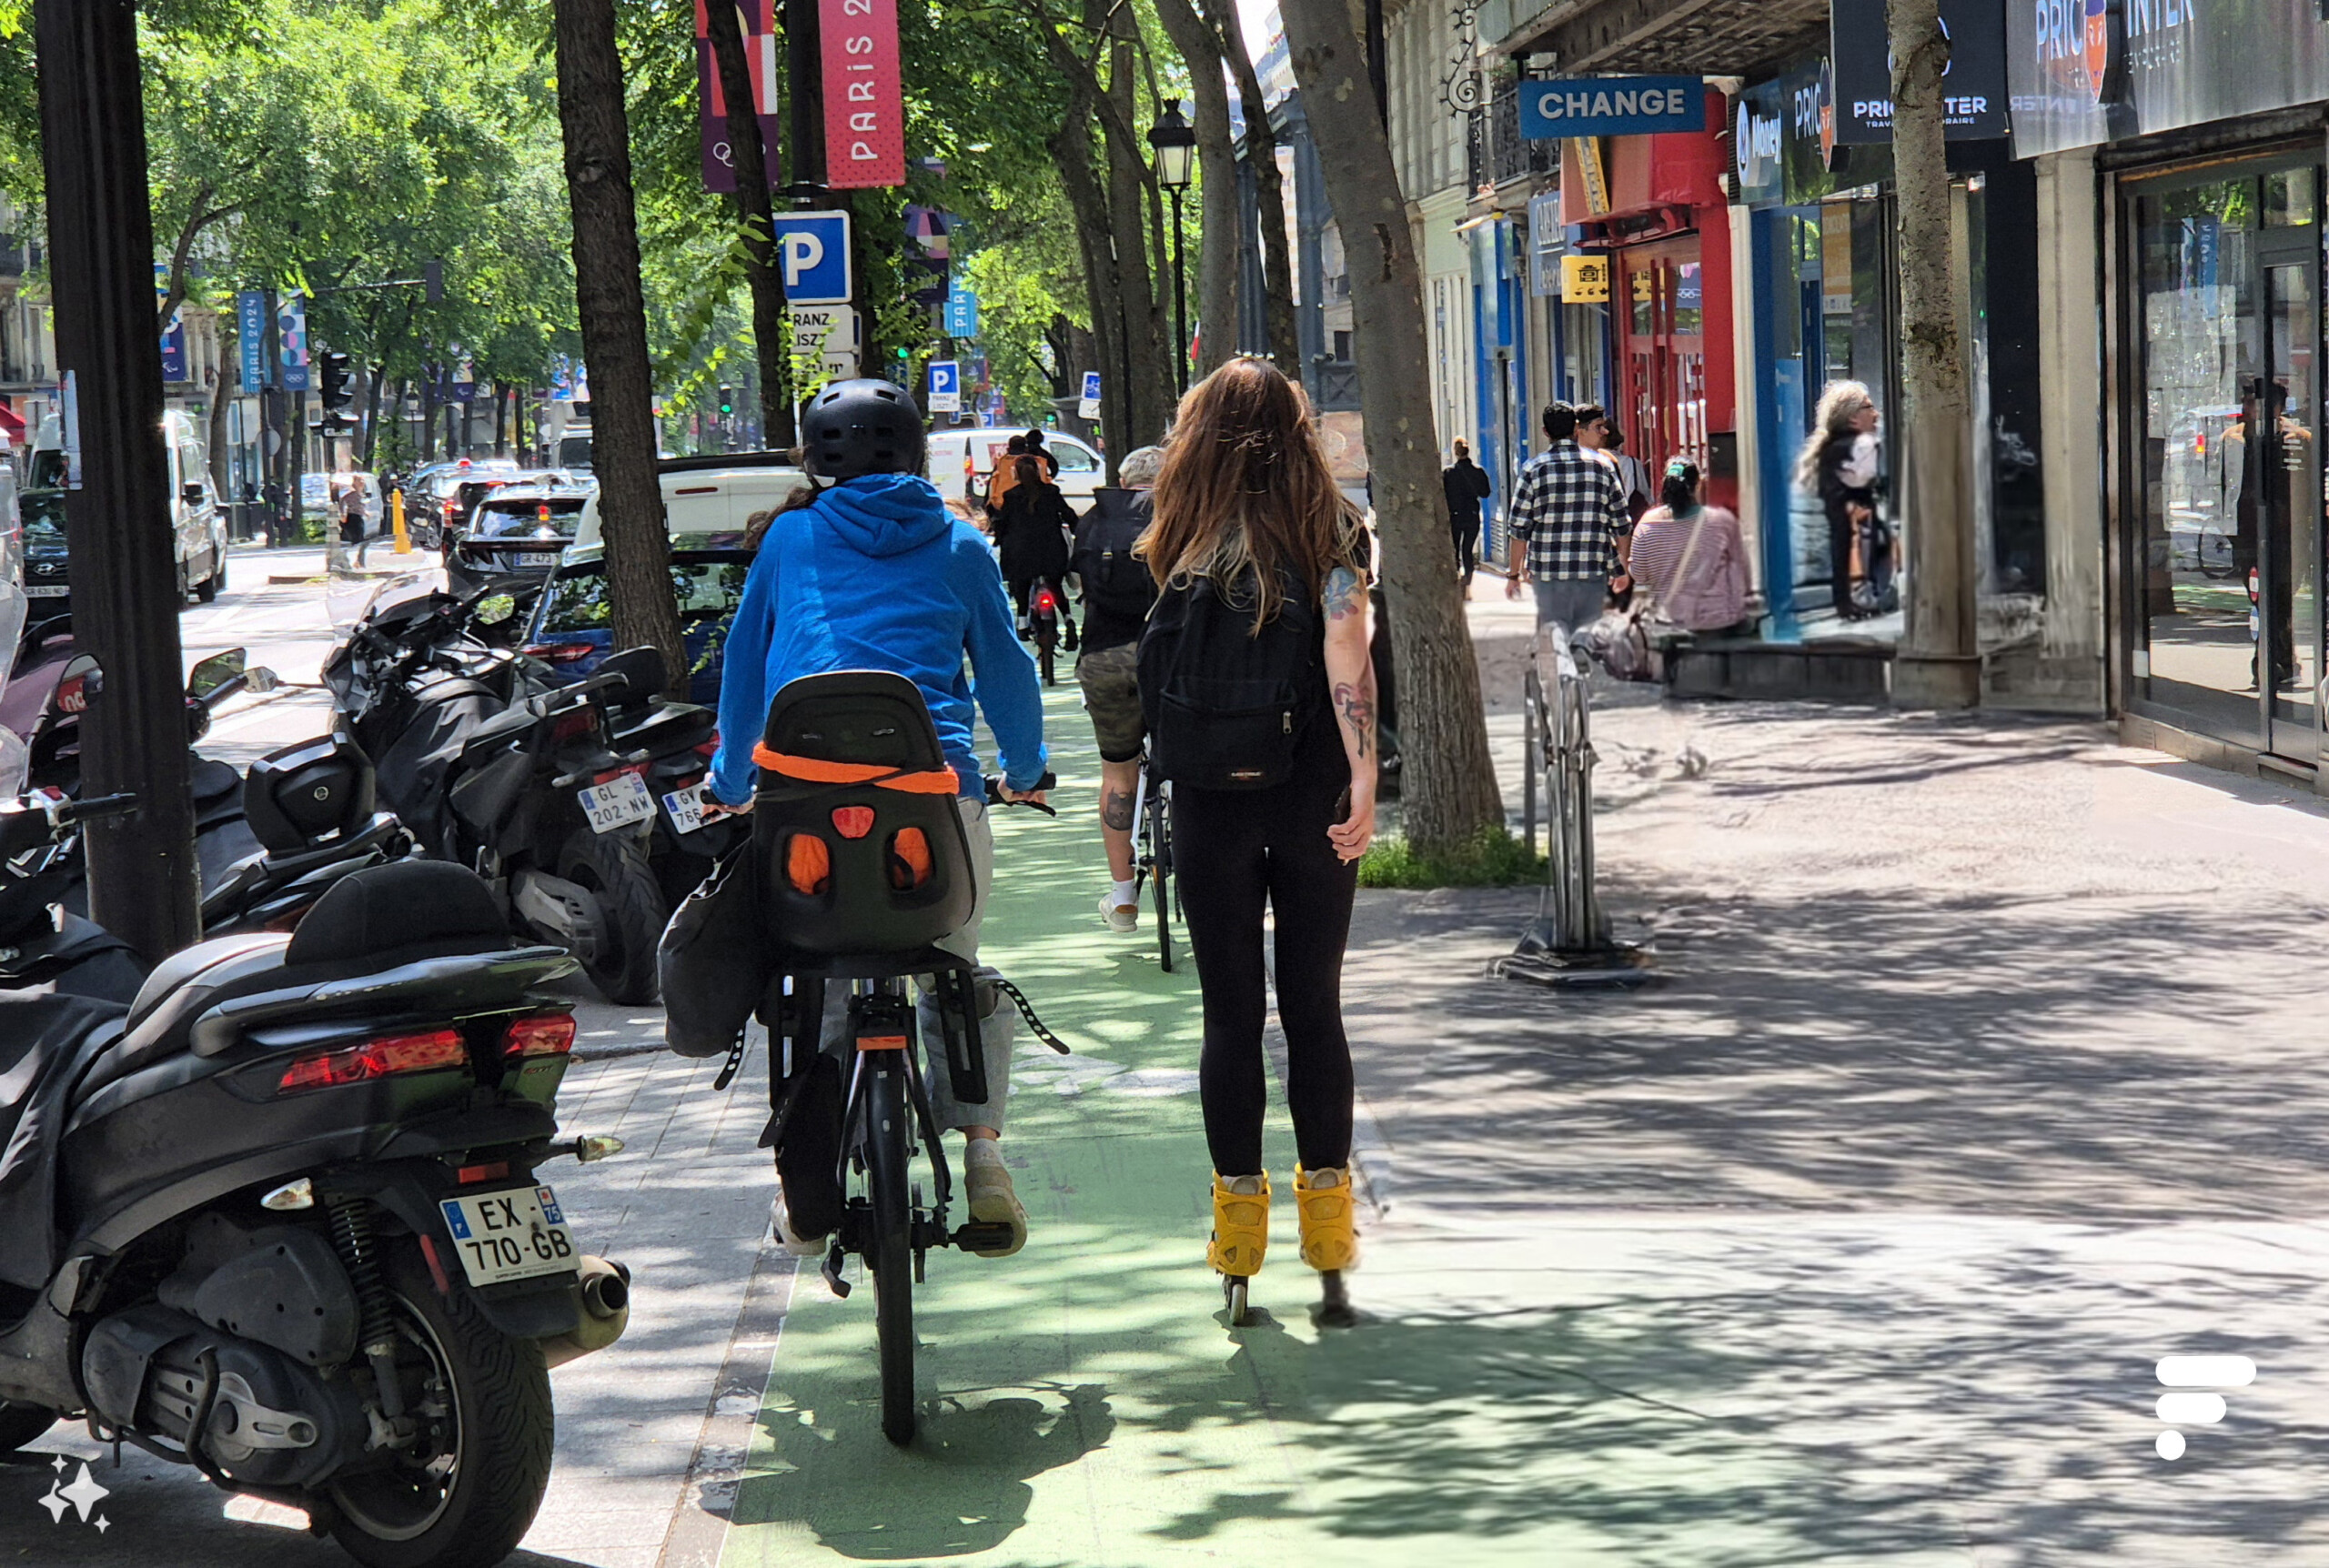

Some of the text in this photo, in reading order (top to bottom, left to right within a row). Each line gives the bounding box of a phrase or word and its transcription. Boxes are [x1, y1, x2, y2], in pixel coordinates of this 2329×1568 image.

[845, 35, 878, 160] PARIS
[1538, 89, 1685, 119] CHANGE
[1752, 109, 1781, 165] Money
[1866, 120, 1893, 128] TRAV
[785, 232, 823, 286] P
[794, 314, 830, 327] RANZ
[797, 334, 827, 346] ISZ
[933, 370, 950, 392] P
[598, 786, 618, 802] GL
[478, 1197, 522, 1231] EX
[544, 1206, 561, 1222] 75
[465, 1229, 571, 1271] 770-GB
